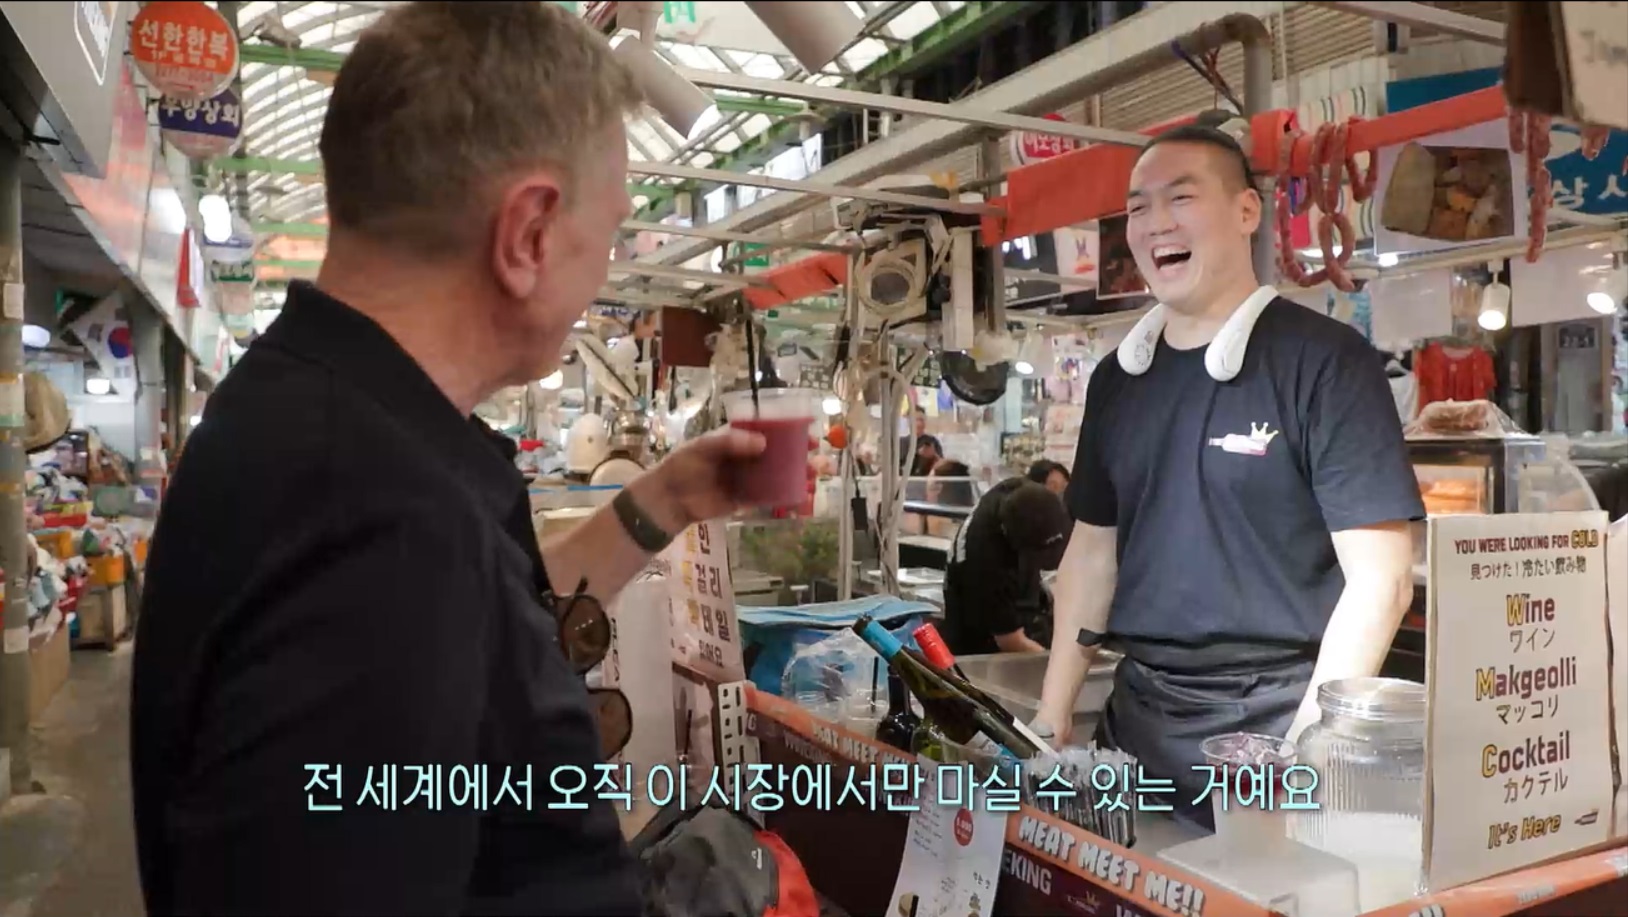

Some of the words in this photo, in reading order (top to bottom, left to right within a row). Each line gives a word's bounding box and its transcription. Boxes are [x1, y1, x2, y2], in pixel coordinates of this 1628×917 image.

[1454, 539, 1476, 555] YOU
[1478, 537, 1506, 553] WERE
[1508, 534, 1549, 551] LOOKING
[1551, 534, 1569, 548] FOR
[1571, 529, 1599, 550] COLD
[1506, 593, 1556, 627] Wine
[1508, 627, 1556, 655] ワイン
[1475, 656, 1578, 702] Makgeolli
[1496, 696, 1560, 726] マッコリ
[1481, 730, 1571, 779] Cocktail
[1503, 767, 1569, 805] カクテル
[1487, 820, 1518, 850] It's
[1520, 812, 1562, 842] Here
[1019, 815, 1076, 861] MEAT
[1077, 841, 1140, 891] MEET
[1144, 870, 1206, 917] ME!!
